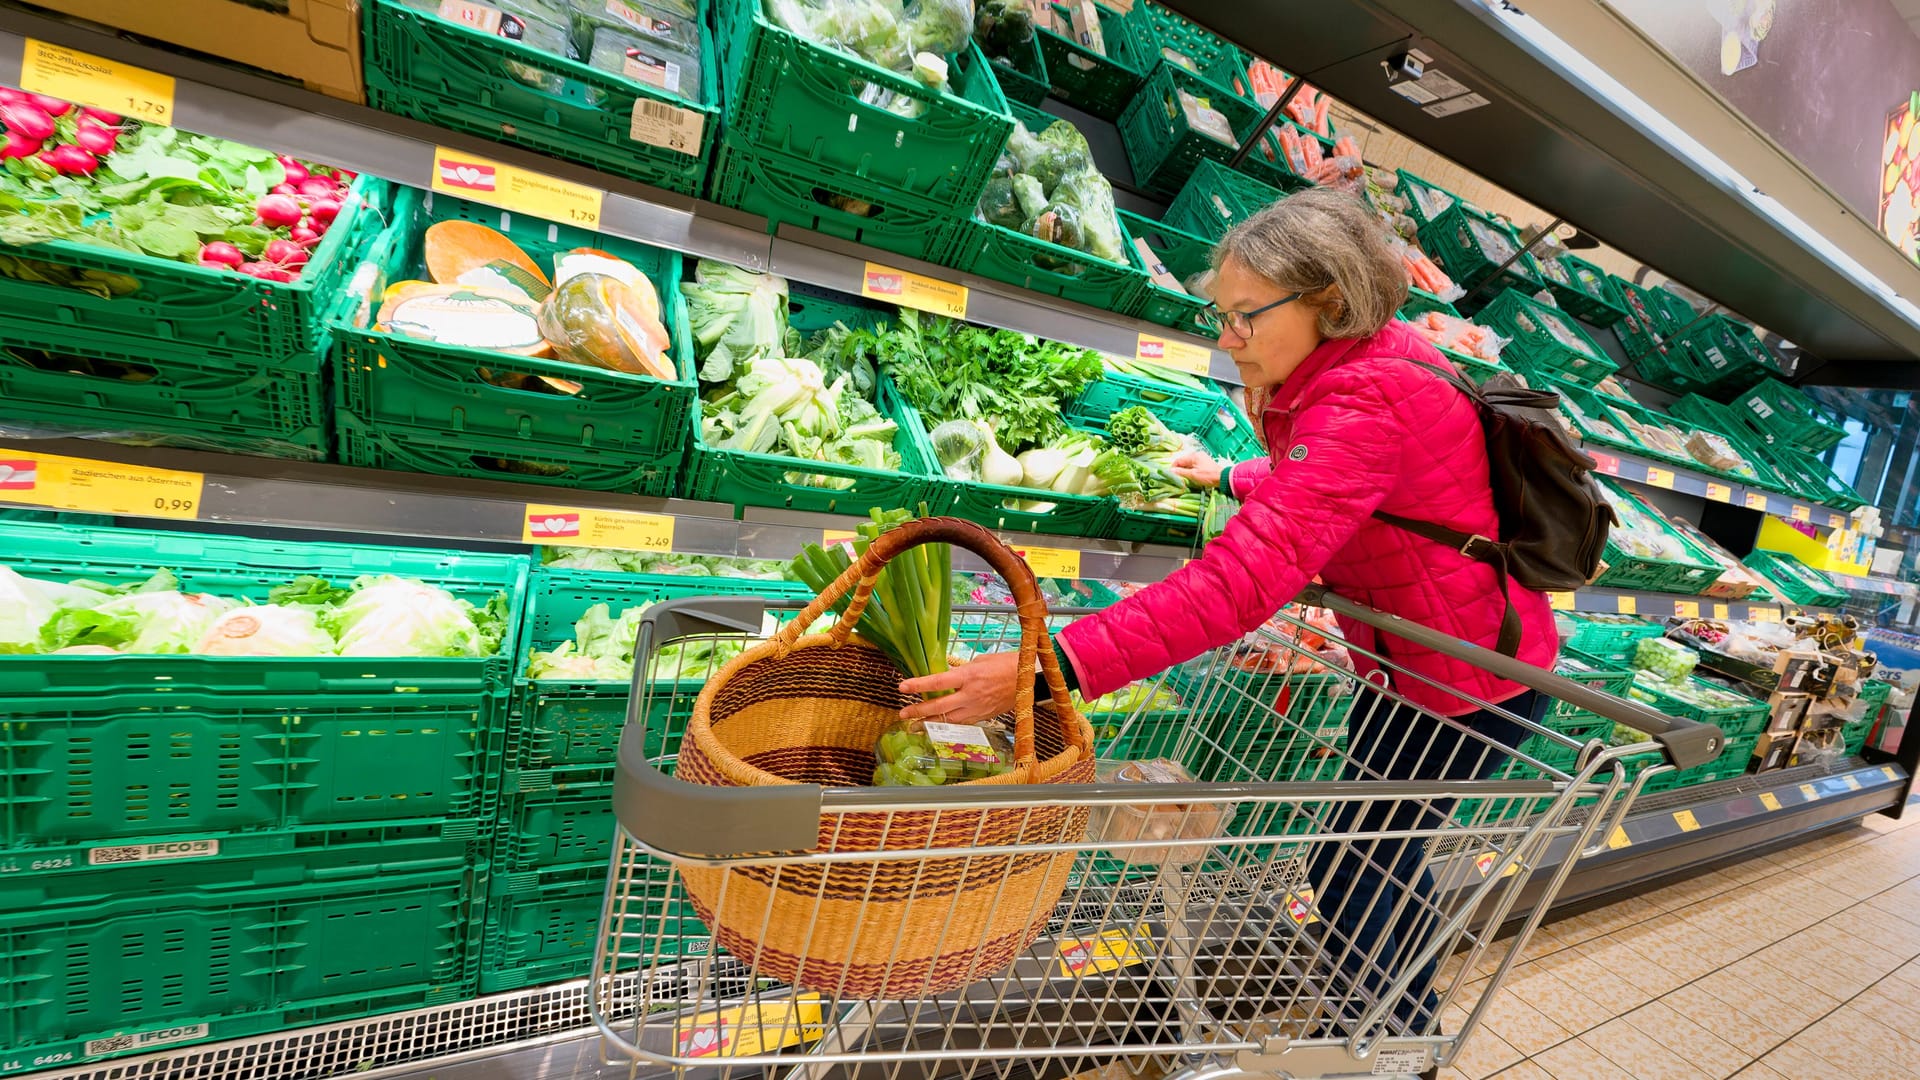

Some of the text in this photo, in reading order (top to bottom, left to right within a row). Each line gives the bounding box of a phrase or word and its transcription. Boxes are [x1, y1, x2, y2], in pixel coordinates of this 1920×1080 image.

[126, 97, 166, 115] 1,79
[562, 188, 595, 202] Österreich
[570, 208, 596, 222] 1,79
[947, 303, 964, 313] 1,49
[72, 468, 193, 488] Radieschen aus Österreich
[154, 497, 193, 511] 0,99
[595, 522, 625, 531] Österreich
[645, 536, 670, 547] 2,49
[1061, 565, 1076, 574] 2,29
[147, 843, 191, 855] IFCO
[31, 857, 74, 871] 6424
[139, 1029, 181, 1043] IFCO
[33, 1052, 74, 1067] 6424
